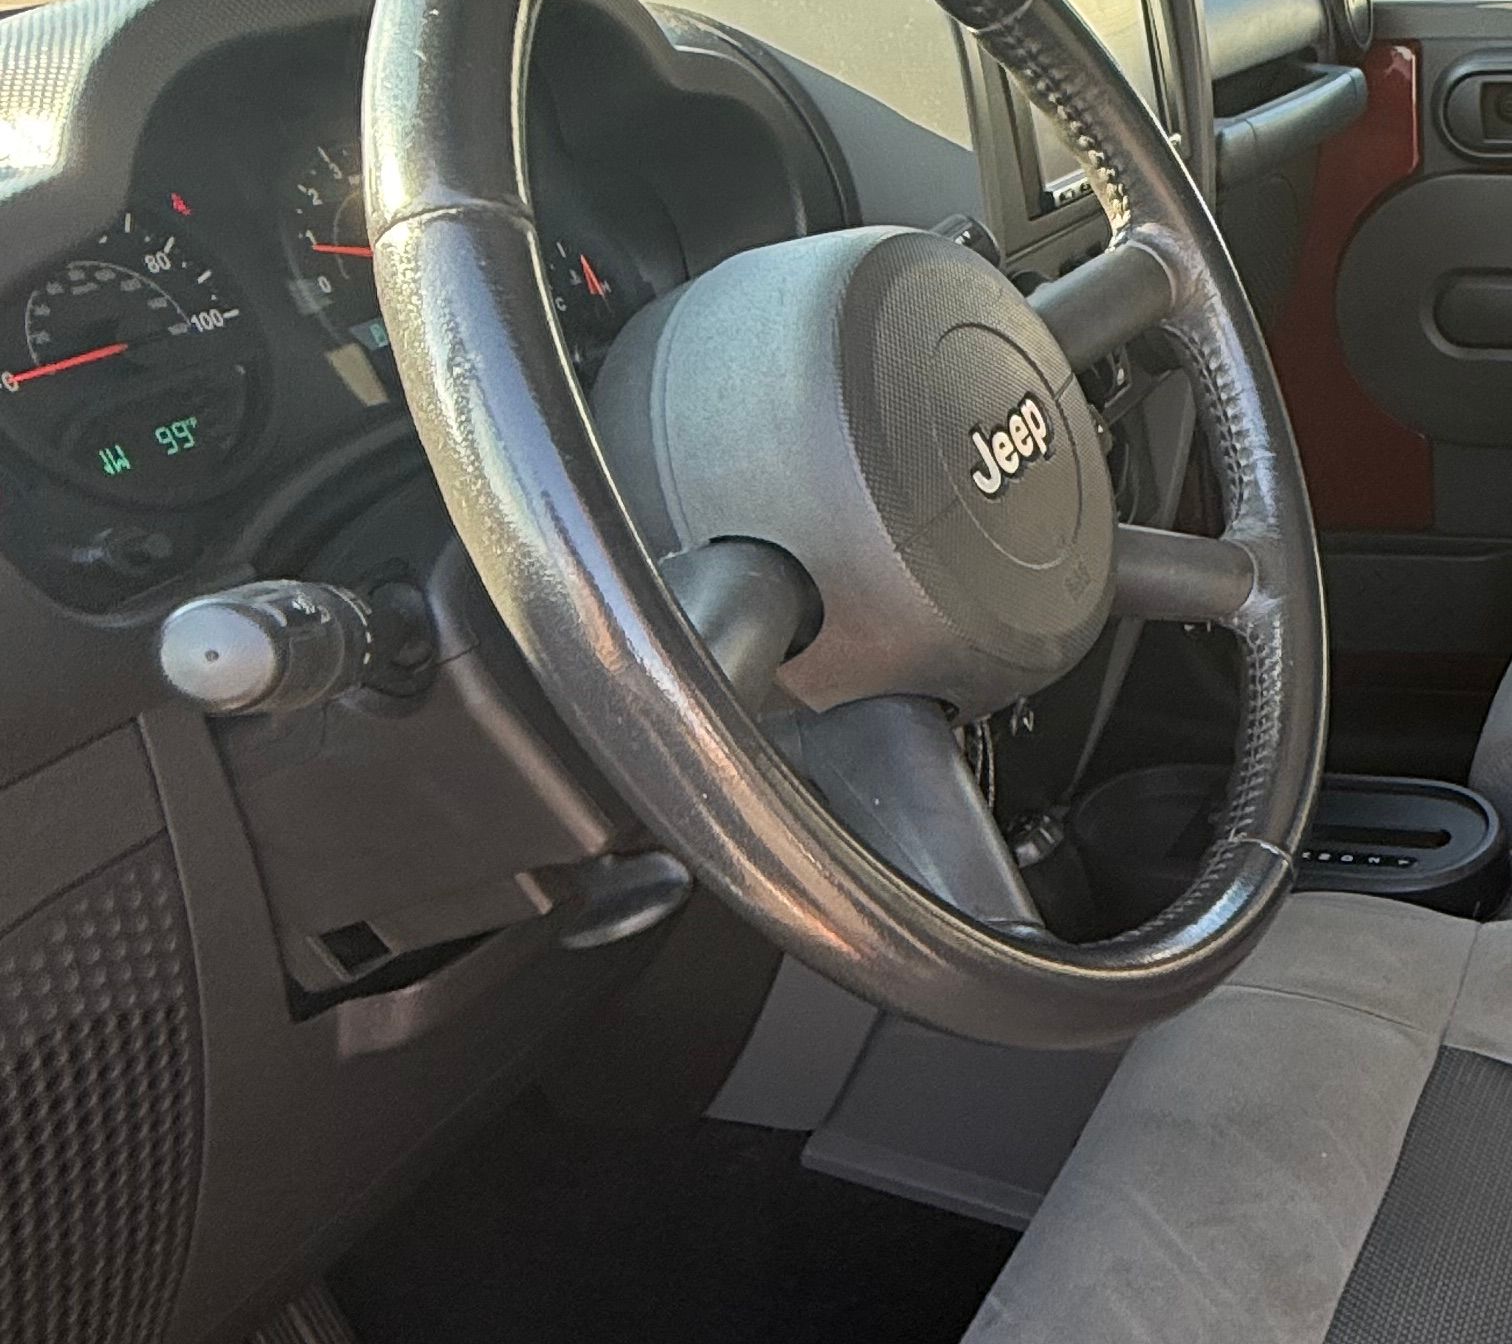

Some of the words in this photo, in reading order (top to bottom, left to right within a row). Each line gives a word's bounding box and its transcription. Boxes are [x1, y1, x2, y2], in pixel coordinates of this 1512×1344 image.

[306, 187, 323, 206] 2
[143, 250, 172, 274] 80
[317, 275, 332, 294] 0
[191, 309, 224, 333] 100
[971, 396, 1048, 495] Jeep
